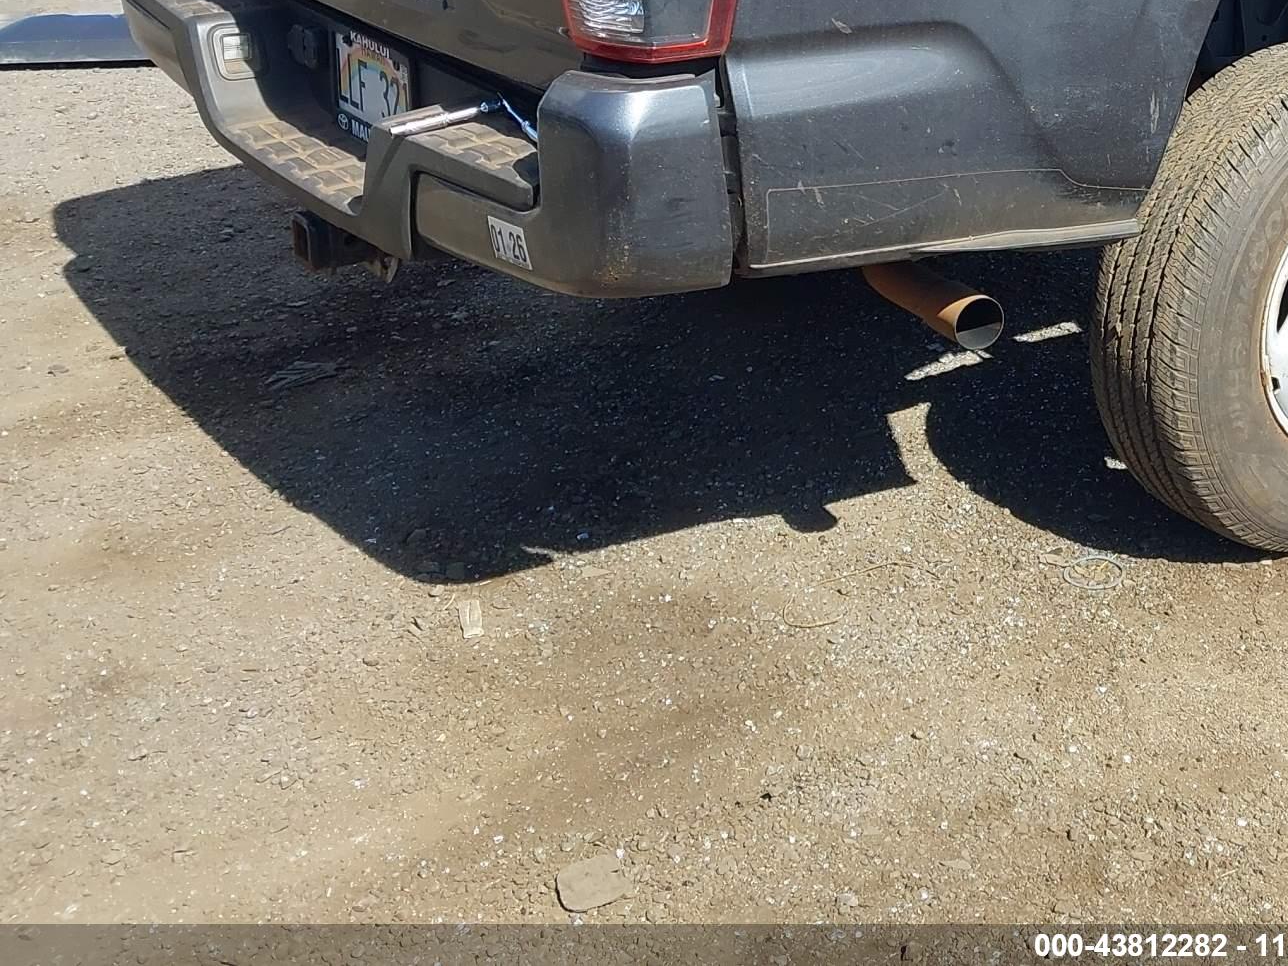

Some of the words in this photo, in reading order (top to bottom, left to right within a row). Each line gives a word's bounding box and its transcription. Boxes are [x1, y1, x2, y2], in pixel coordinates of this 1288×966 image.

[350, 30, 390, 59] KAHULUI
[336, 47, 368, 112] LLF
[490, 224, 507, 255] 01
[509, 231, 527, 263] 26
